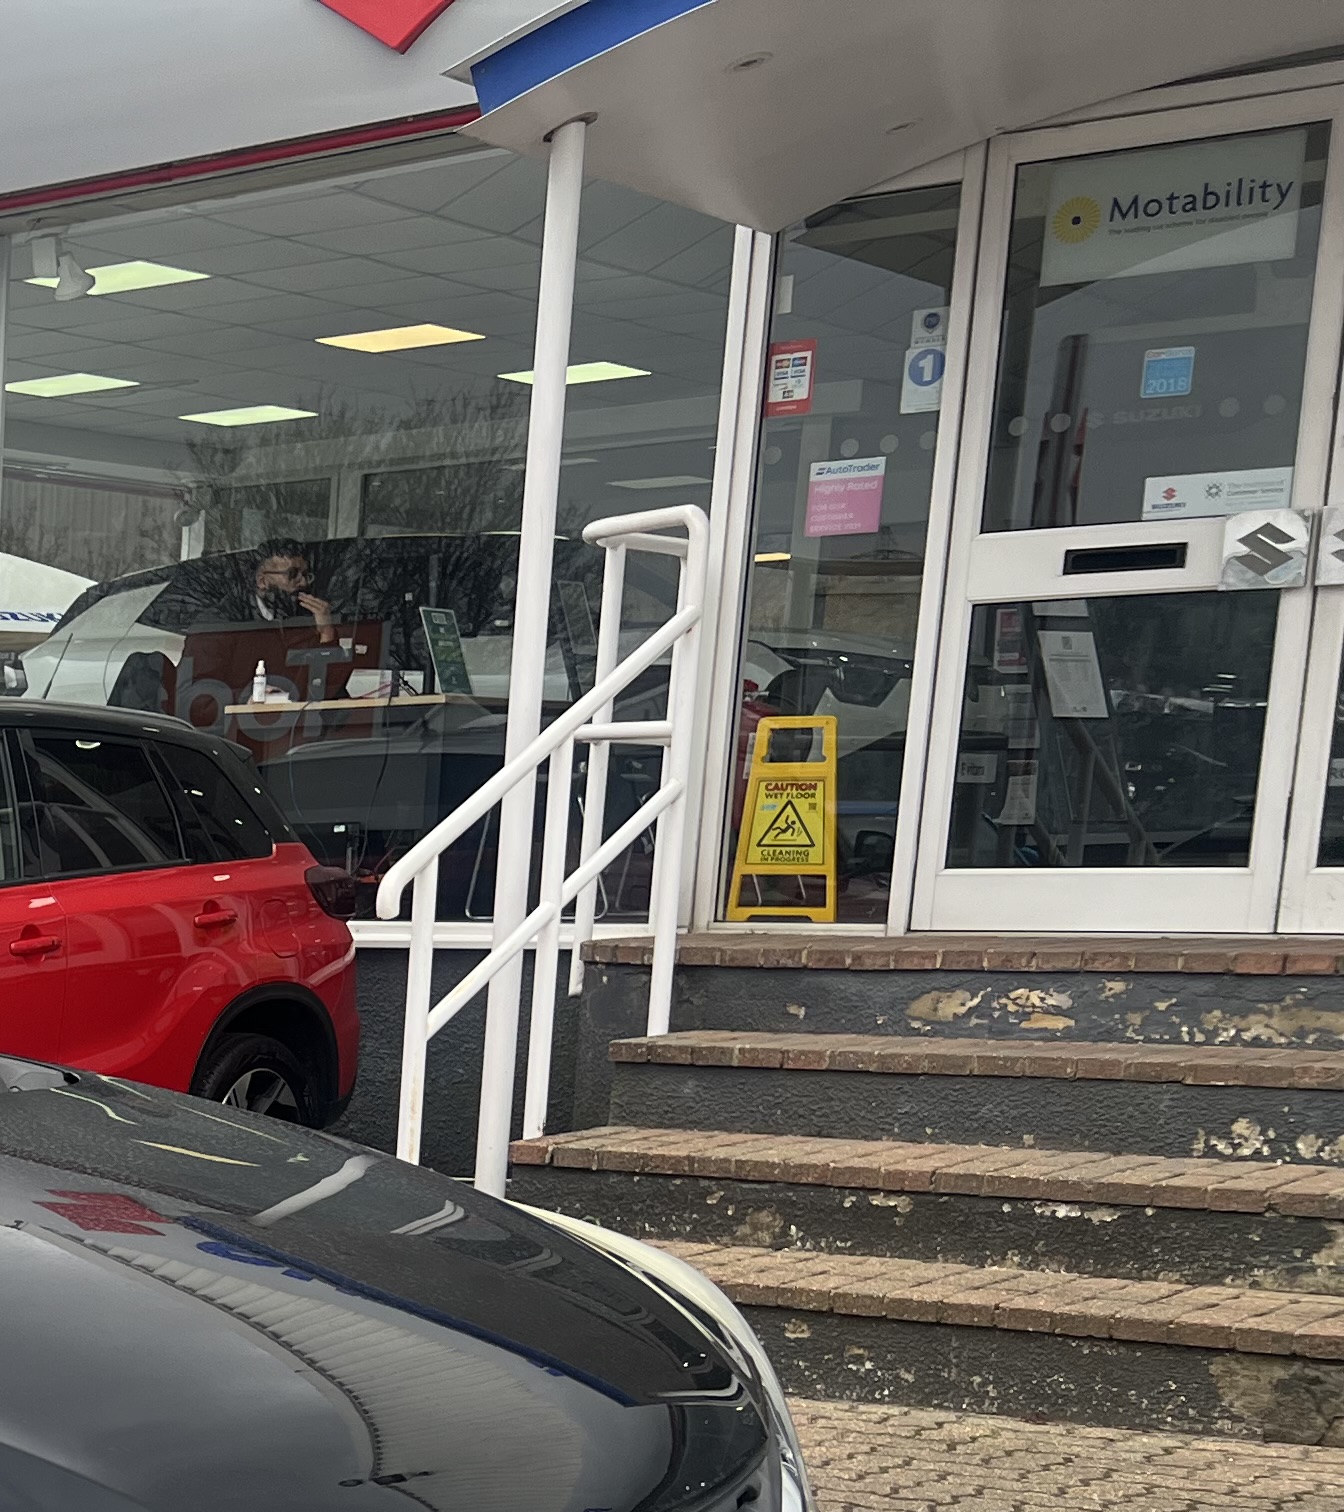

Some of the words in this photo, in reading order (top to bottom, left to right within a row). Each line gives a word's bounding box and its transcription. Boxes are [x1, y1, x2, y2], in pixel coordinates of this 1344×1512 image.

[1109, 177, 1294, 222] Motability
[918, 354, 934, 382] 1
[1146, 377, 1188, 394] 2018
[825, 463, 881, 475] AutoTrader
[764, 782, 818, 791] CAUTION
[760, 849, 810, 857] CLEANING
